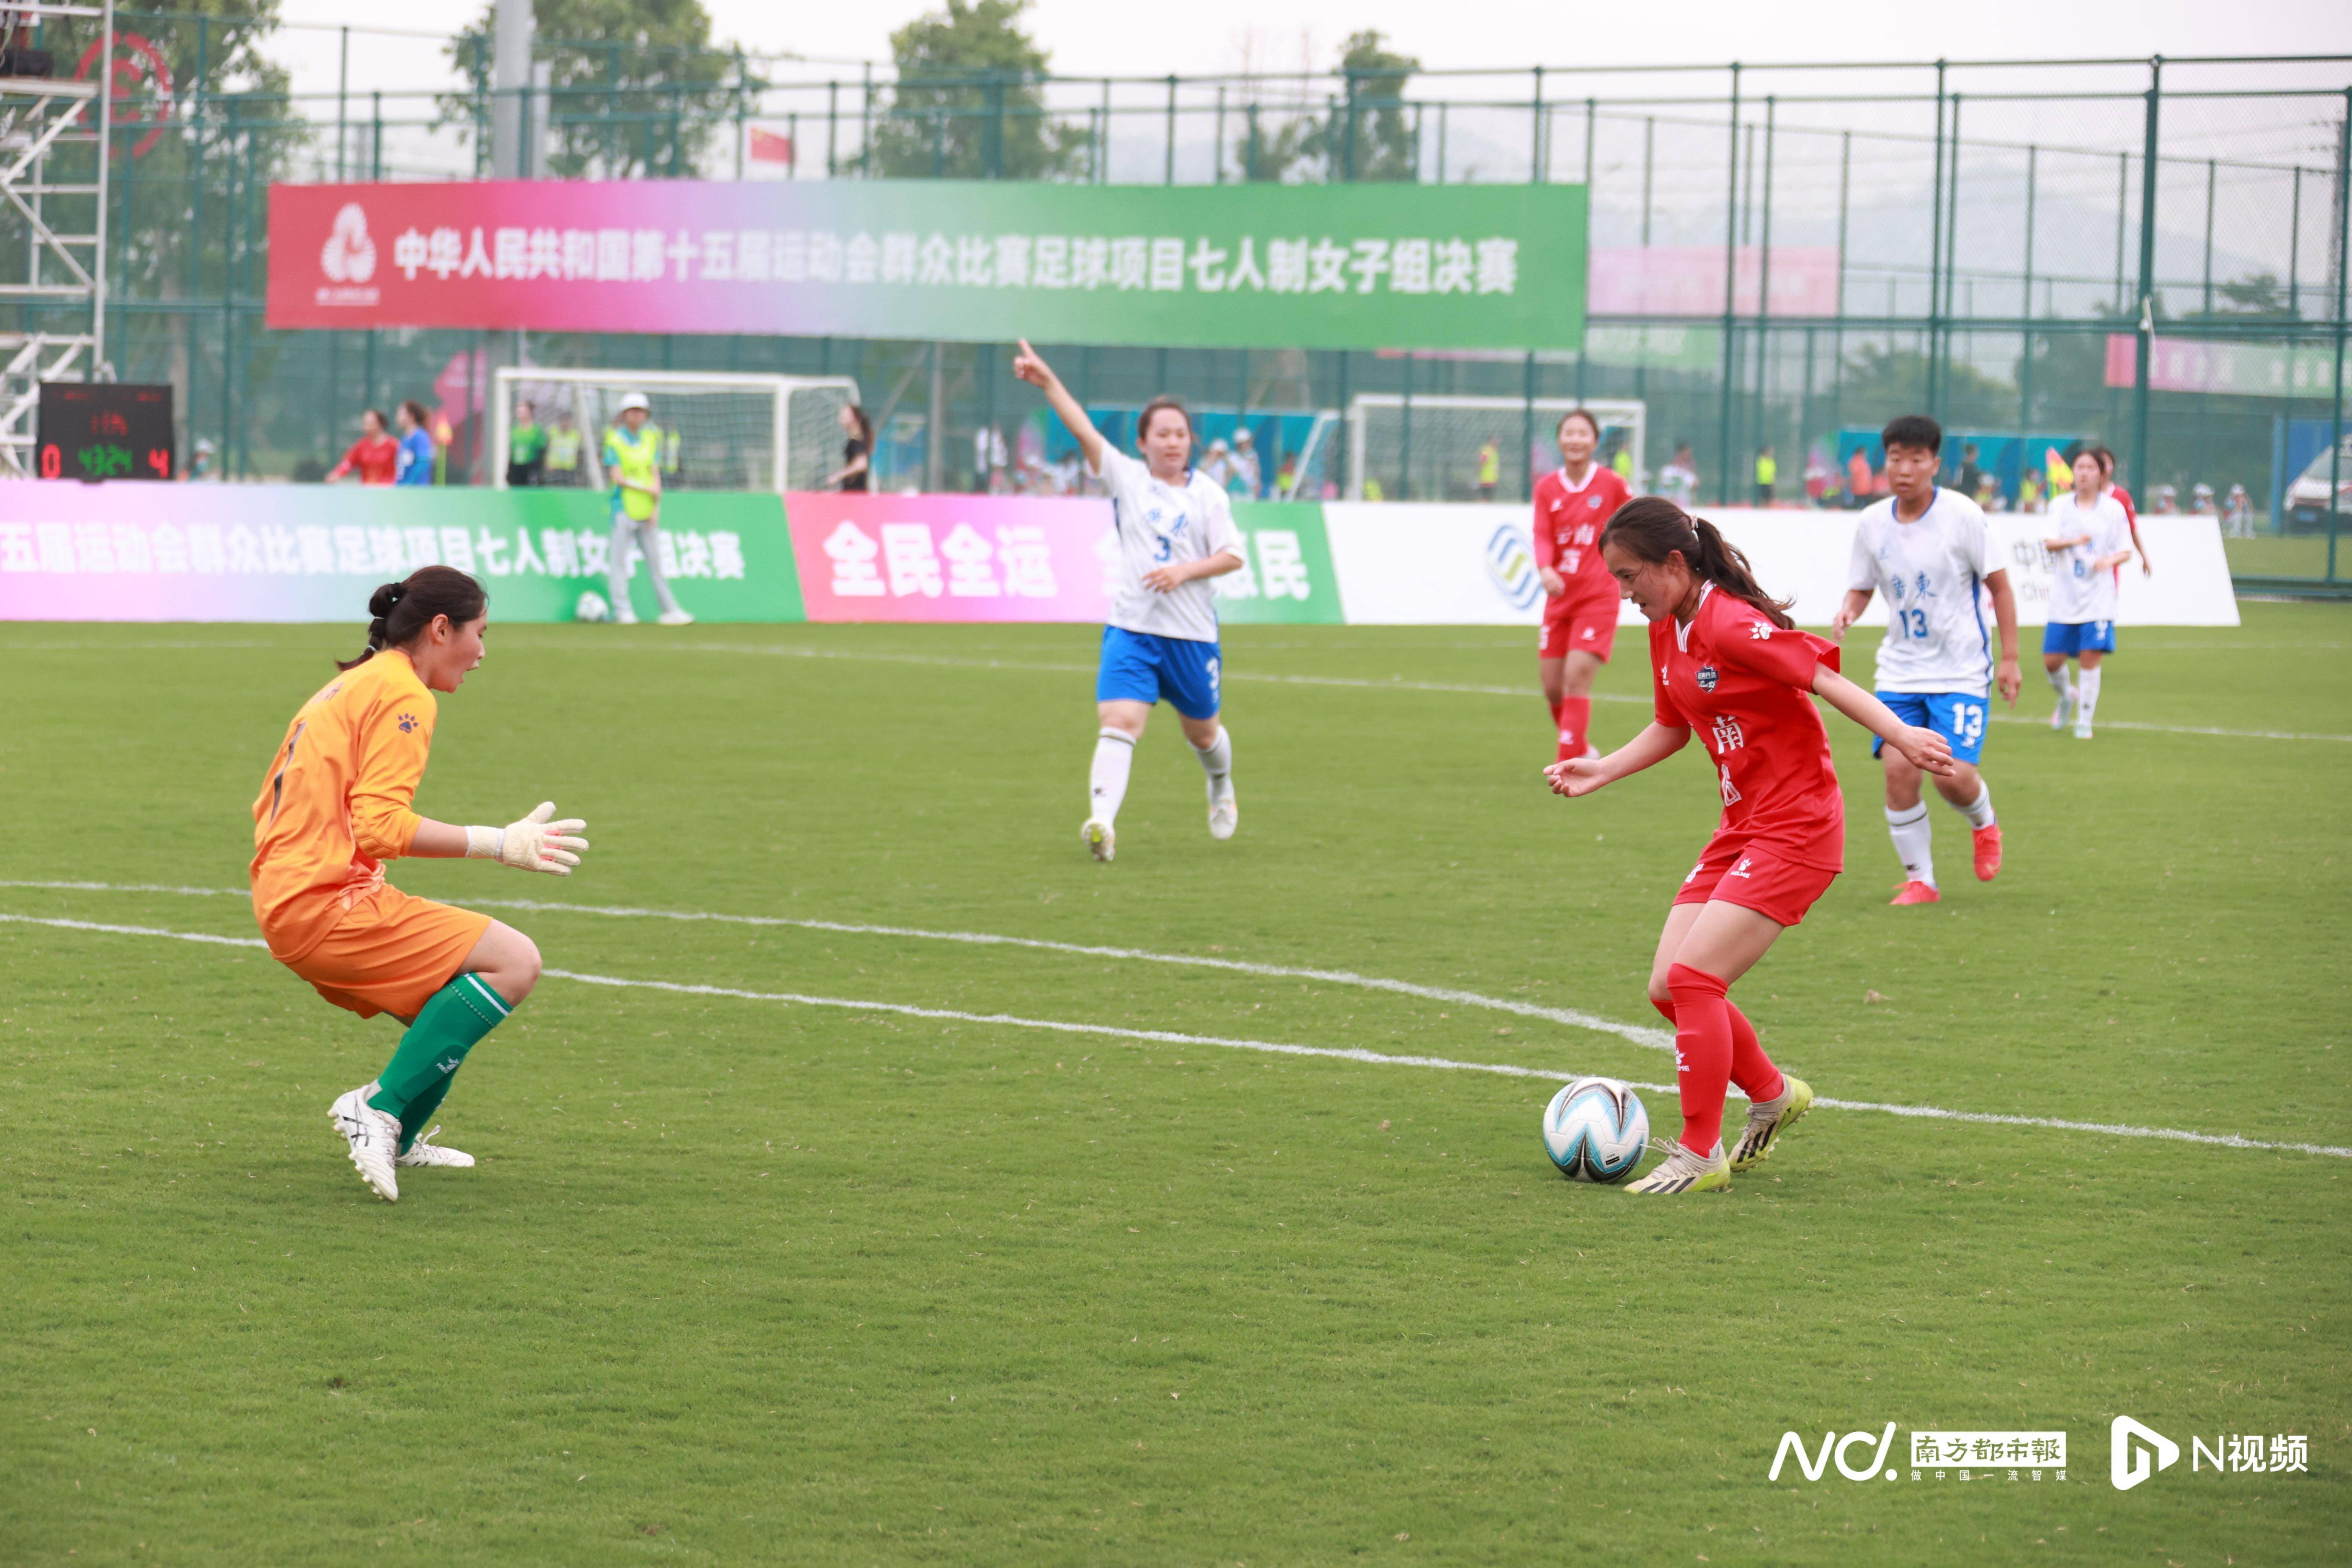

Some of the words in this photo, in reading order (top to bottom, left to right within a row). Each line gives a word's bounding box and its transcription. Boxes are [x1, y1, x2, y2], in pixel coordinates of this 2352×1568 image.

[394, 227, 1518, 294] 中华人民共和国第十五届运动会群众比赛足球项目七人制女子组决赛
[42, 443, 61, 480] 0
[148, 448, 168, 478] 4
[823, 521, 1058, 598] 全民全运
[1154, 535, 1171, 562] 3
[1899, 609, 1928, 639] 13
[1206, 657, 1220, 690] 3
[1952, 703, 1983, 737] 13
